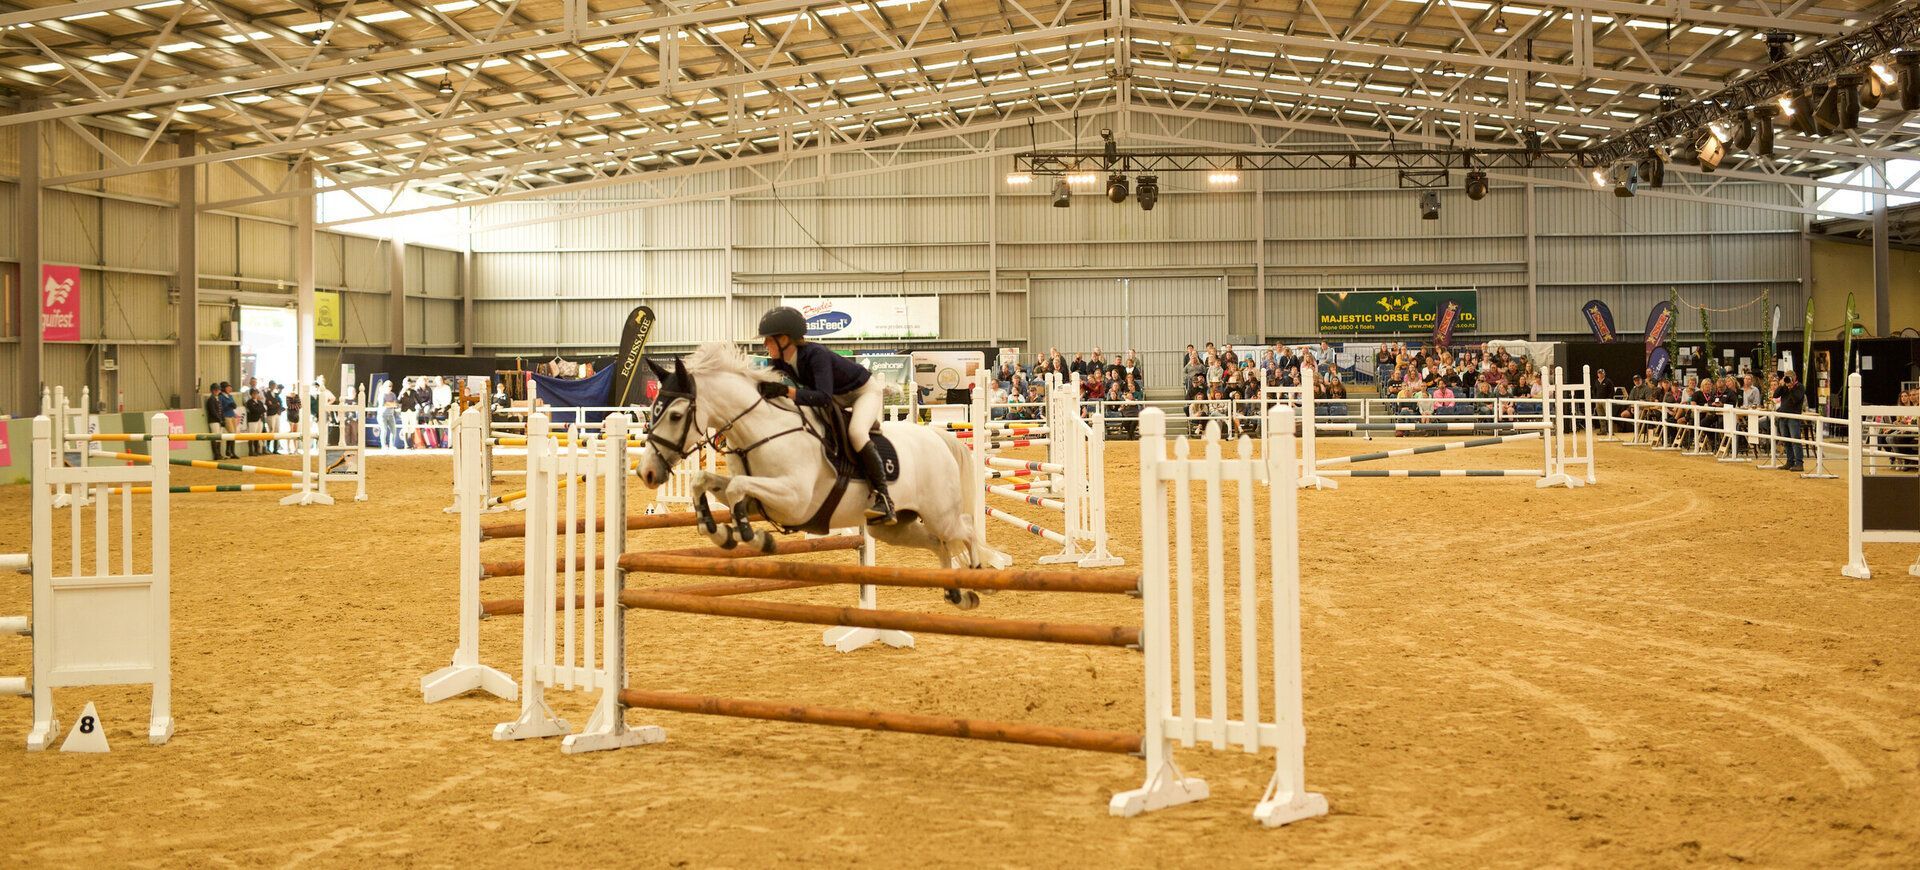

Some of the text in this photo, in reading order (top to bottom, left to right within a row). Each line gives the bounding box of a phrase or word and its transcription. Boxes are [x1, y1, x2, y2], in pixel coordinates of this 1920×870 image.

[42, 309, 73, 331] quifest
[806, 319, 844, 330] asiFeed
[1321, 314, 1372, 323] MAJESTIC
[1374, 313, 1410, 322] HORSE
[621, 319, 651, 377] EQUISSAGE
[871, 361, 904, 370] Seahorse
[80, 716, 94, 734] 8
